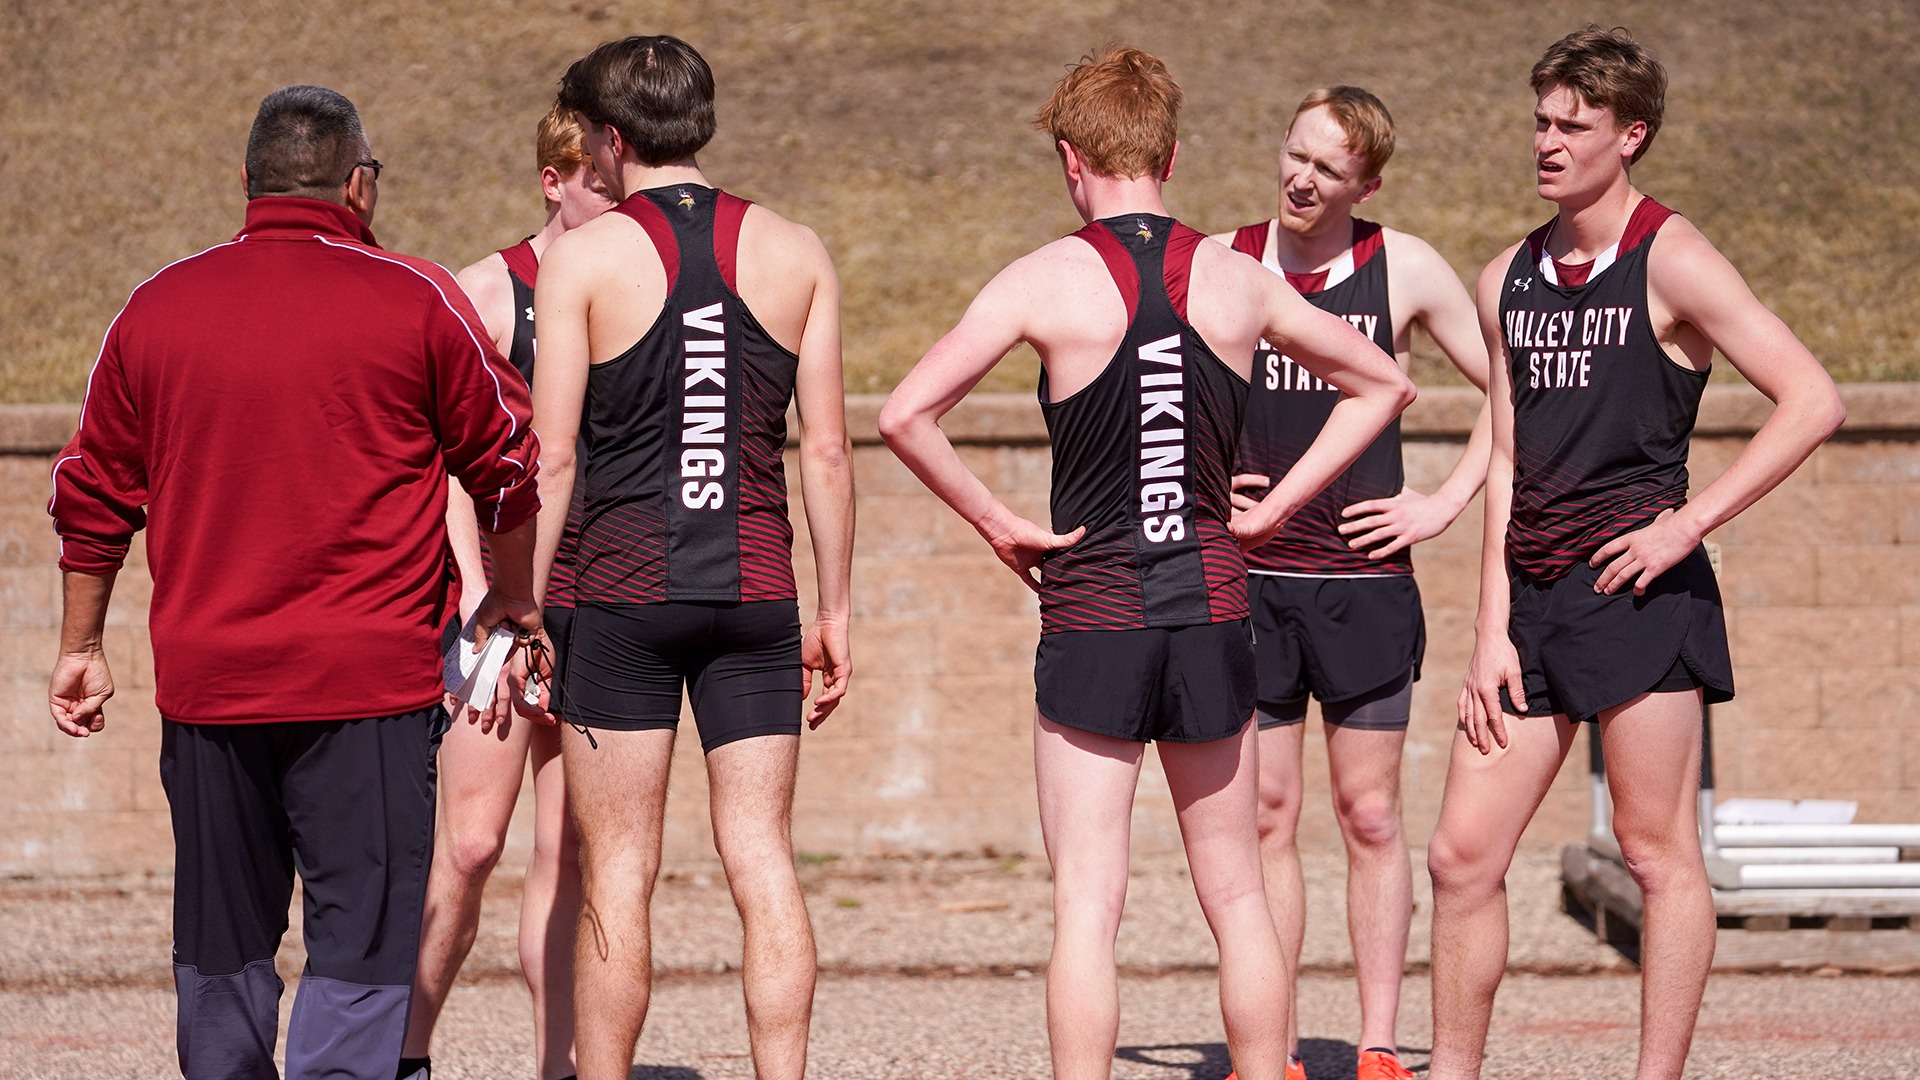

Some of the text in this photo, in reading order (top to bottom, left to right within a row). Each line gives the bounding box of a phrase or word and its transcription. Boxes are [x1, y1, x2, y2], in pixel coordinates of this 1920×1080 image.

[1506, 307, 1633, 348] VALLEY CITY
[1265, 353, 1340, 391] STA
[1529, 350, 1592, 390] STATE
[680, 301, 726, 511] VIKINGS
[1138, 333, 1185, 543] VIKINGS
